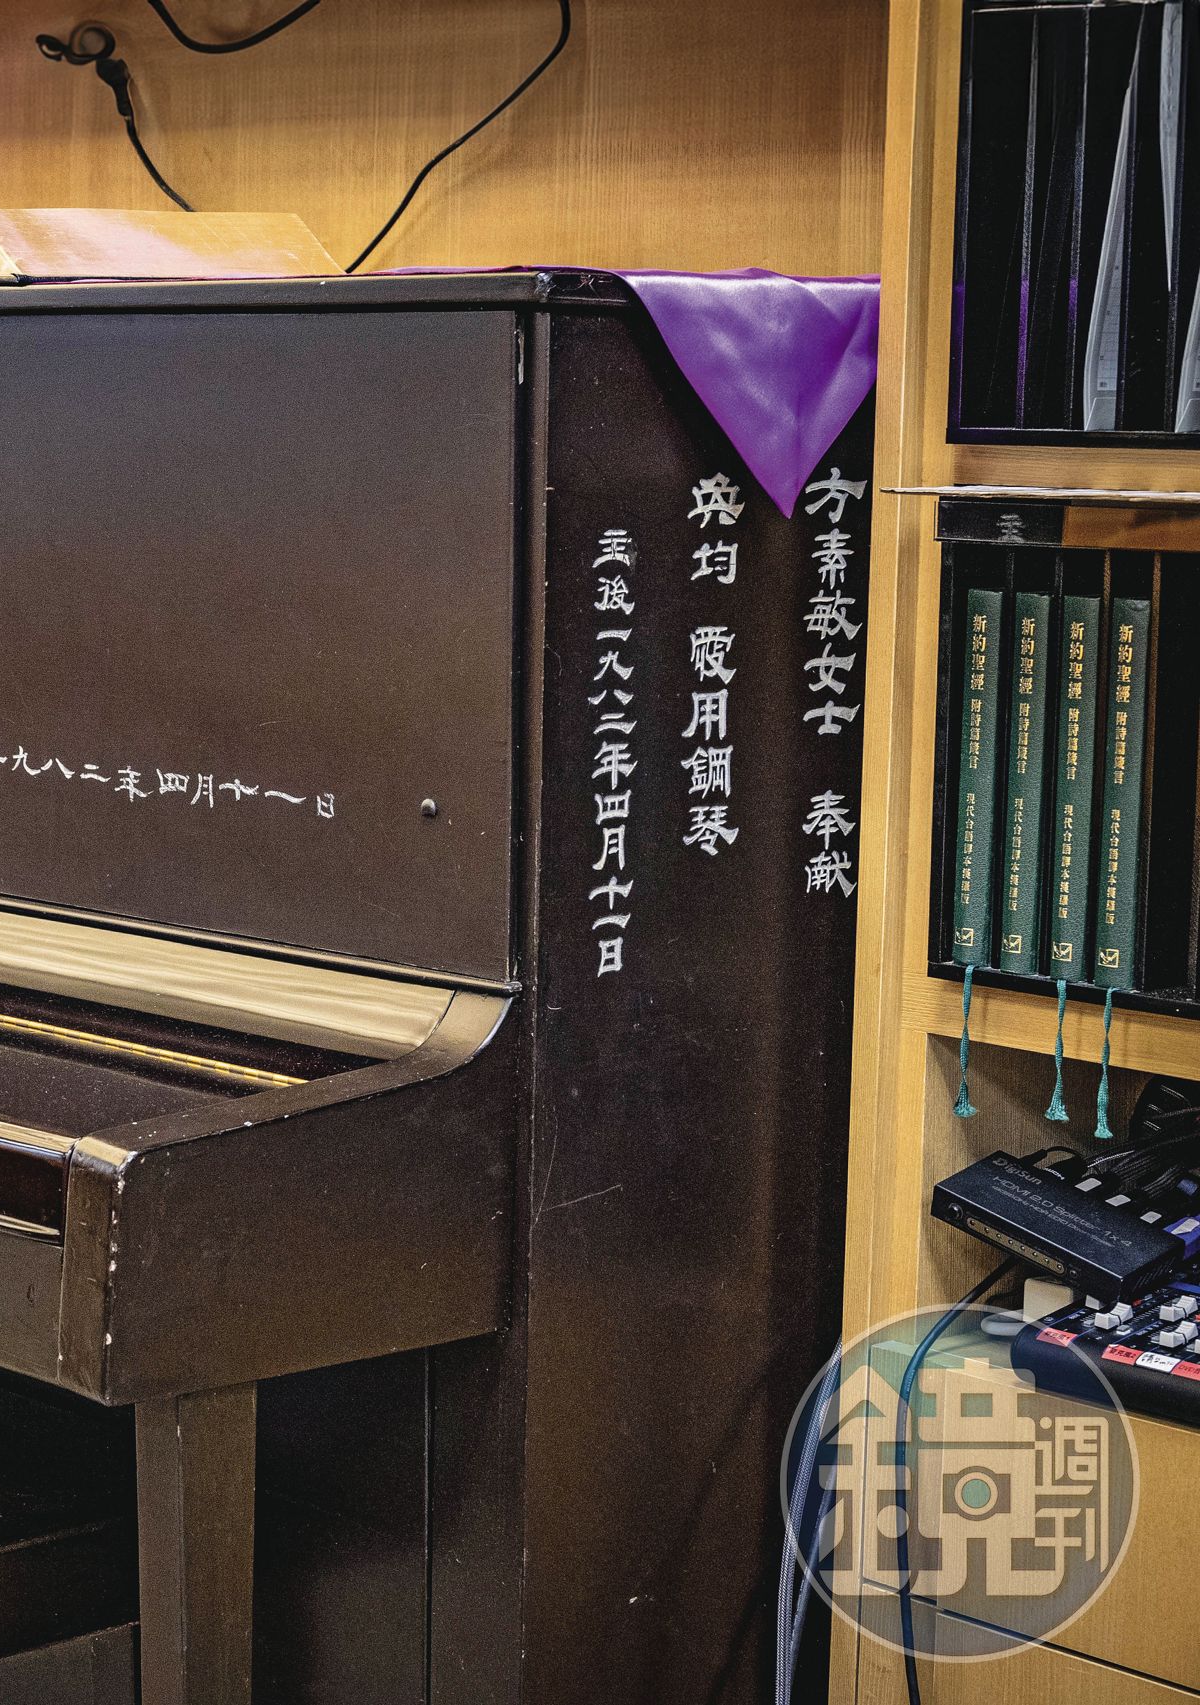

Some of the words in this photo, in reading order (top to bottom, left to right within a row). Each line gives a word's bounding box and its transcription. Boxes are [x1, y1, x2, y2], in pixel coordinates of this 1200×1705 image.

[803, 467, 867, 735] 方素敏女士
[971, 614, 987, 690] 新約聖經
[1019, 617, 1035, 695] 新約聖經
[1068, 621, 1084, 699] 新約聖經
[1116, 624, 1134, 703] 新約聖經
[588, 528, 637, 978] 主後一九八二年四月十一日
[993, 1176, 1031, 1196] HDMI
[1029, 1194, 1054, 1208] 2.0
[1053, 1206, 1101, 1231] Splitter
